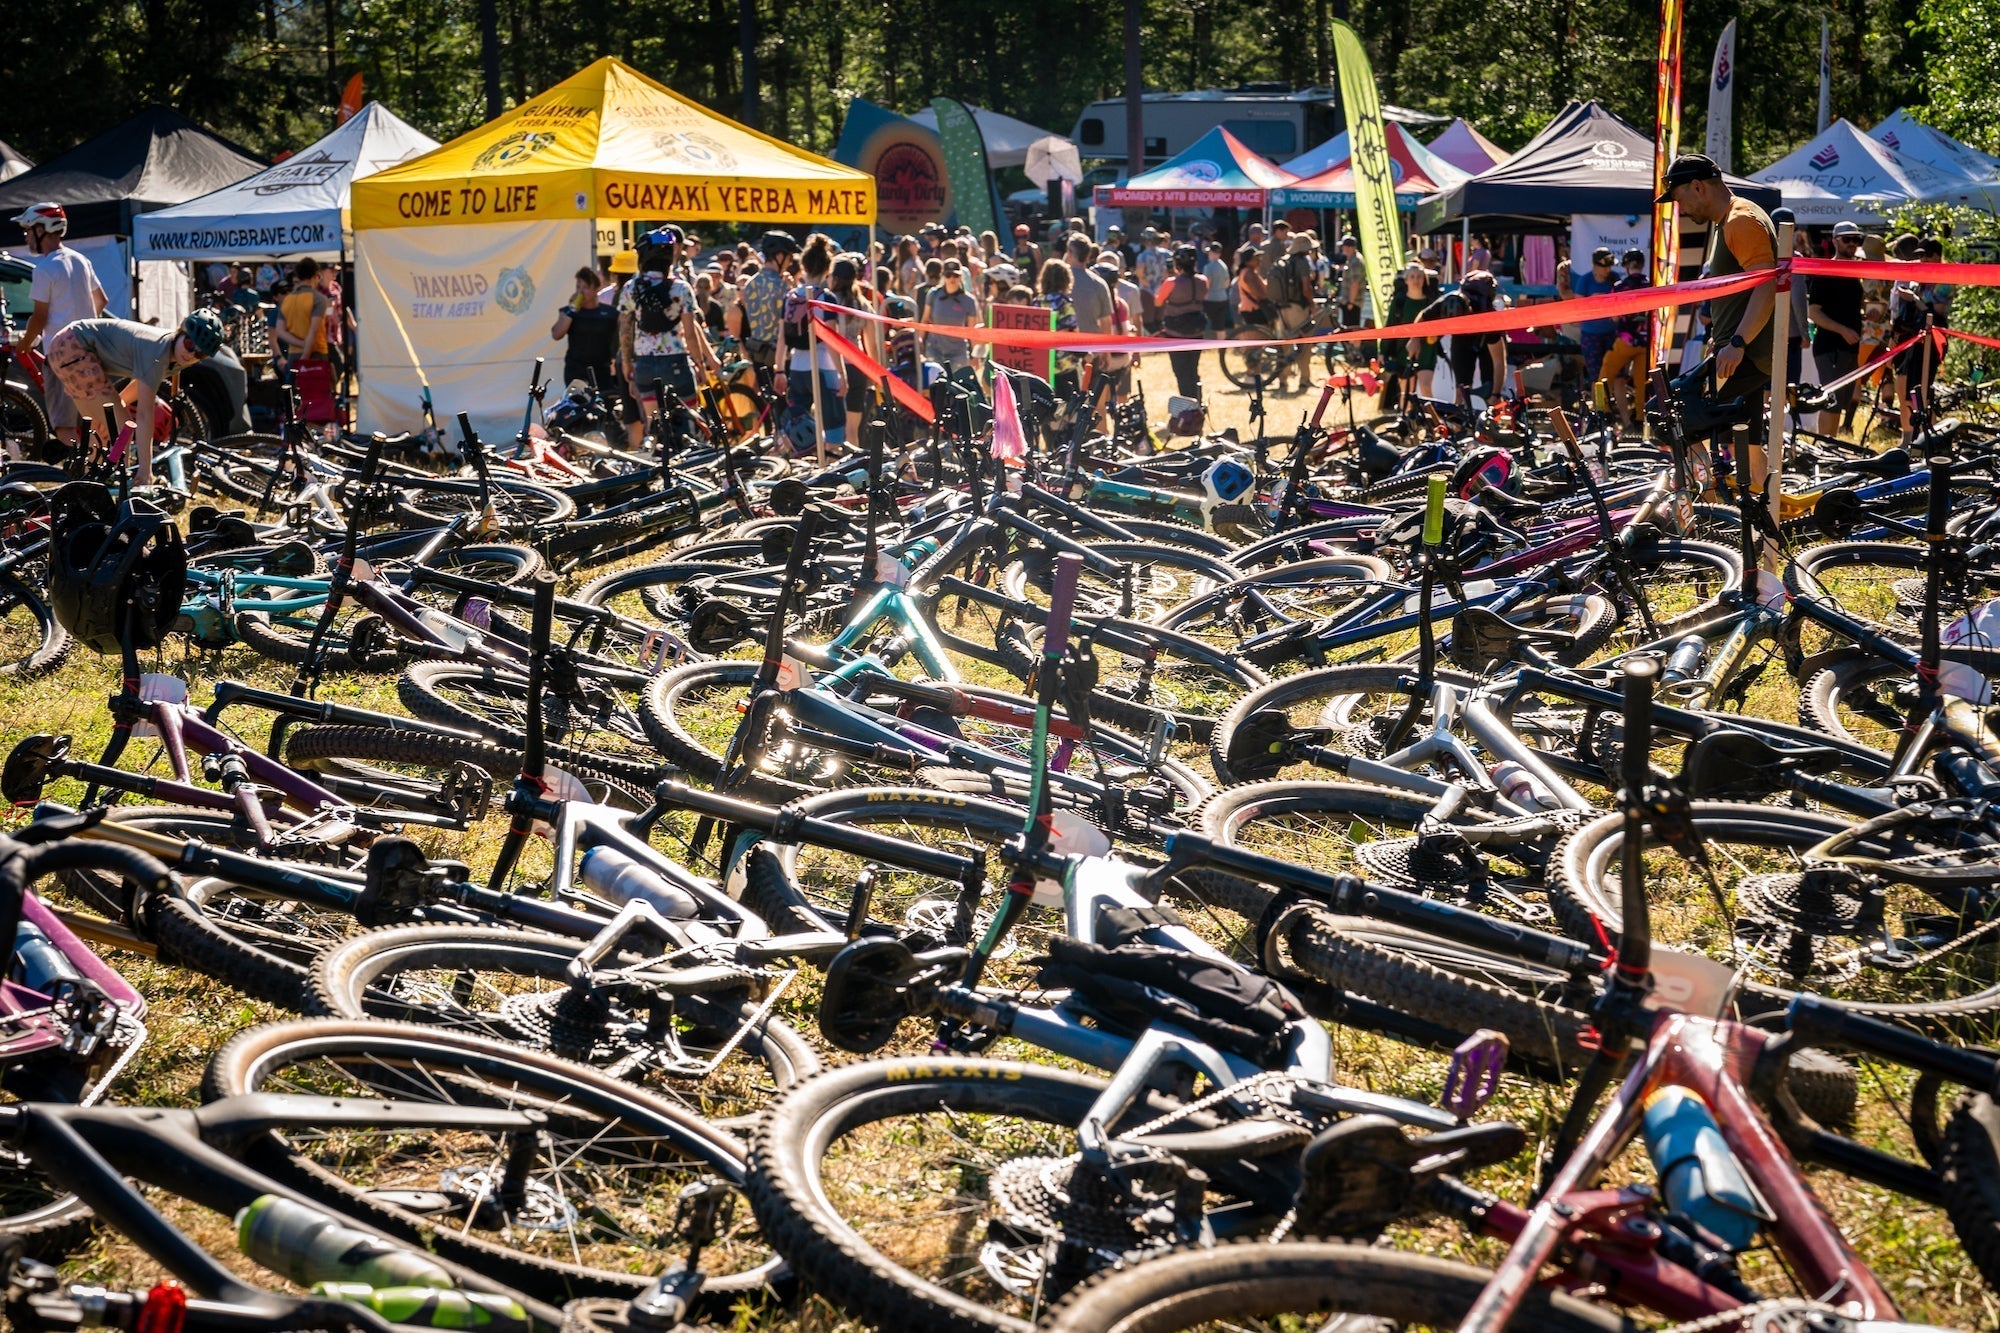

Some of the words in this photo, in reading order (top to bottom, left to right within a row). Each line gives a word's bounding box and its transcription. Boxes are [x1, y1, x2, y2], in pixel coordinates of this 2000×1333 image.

[398, 189, 453, 219] COME
[460, 187, 487, 216] TO
[494, 185, 539, 213] LIFE
[605, 181, 711, 212] GUAYAKÍ
[718, 186, 798, 214] YERBA
[808, 188, 867, 215] MATE
[1113, 190, 1163, 201] WOMEN'S
[1165, 191, 1186, 201] MTB
[1188, 191, 1232, 202] ENDURO
[1233, 192, 1261, 203] RACE
[1289, 193, 1342, 204] WOMEN'S
[149, 225, 324, 250] WWW.RIDINGBRAVE.COM
[1599, 235, 1627, 245] Mount
[996, 311, 1050, 329] PLEASE
[867, 791, 967, 807] MAXXIS
[886, 1064, 1023, 1082] MAXXIS
